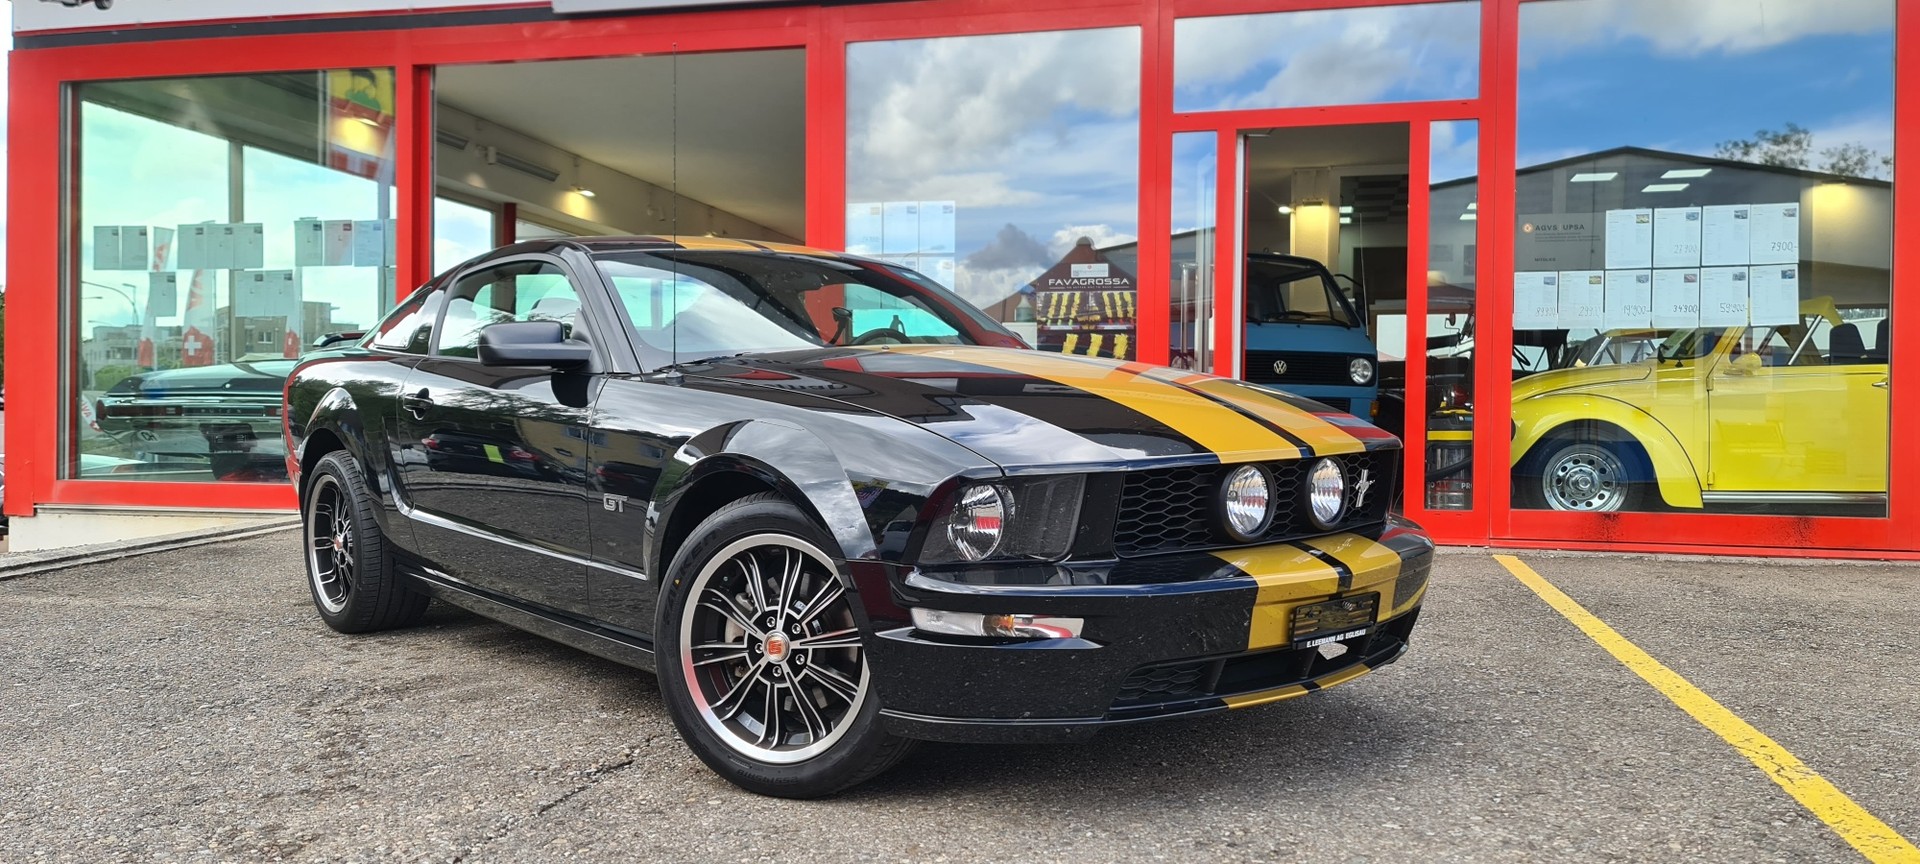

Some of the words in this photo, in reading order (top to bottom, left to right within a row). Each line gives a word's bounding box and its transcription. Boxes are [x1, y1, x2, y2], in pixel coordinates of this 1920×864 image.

[1562, 223, 1585, 231] UPSA
[1048, 278, 1130, 286] FAVAGROSSA
[603, 493, 629, 513] GT
[1312, 636, 1336, 646] LEEMANN
[1336, 633, 1344, 641] AG
